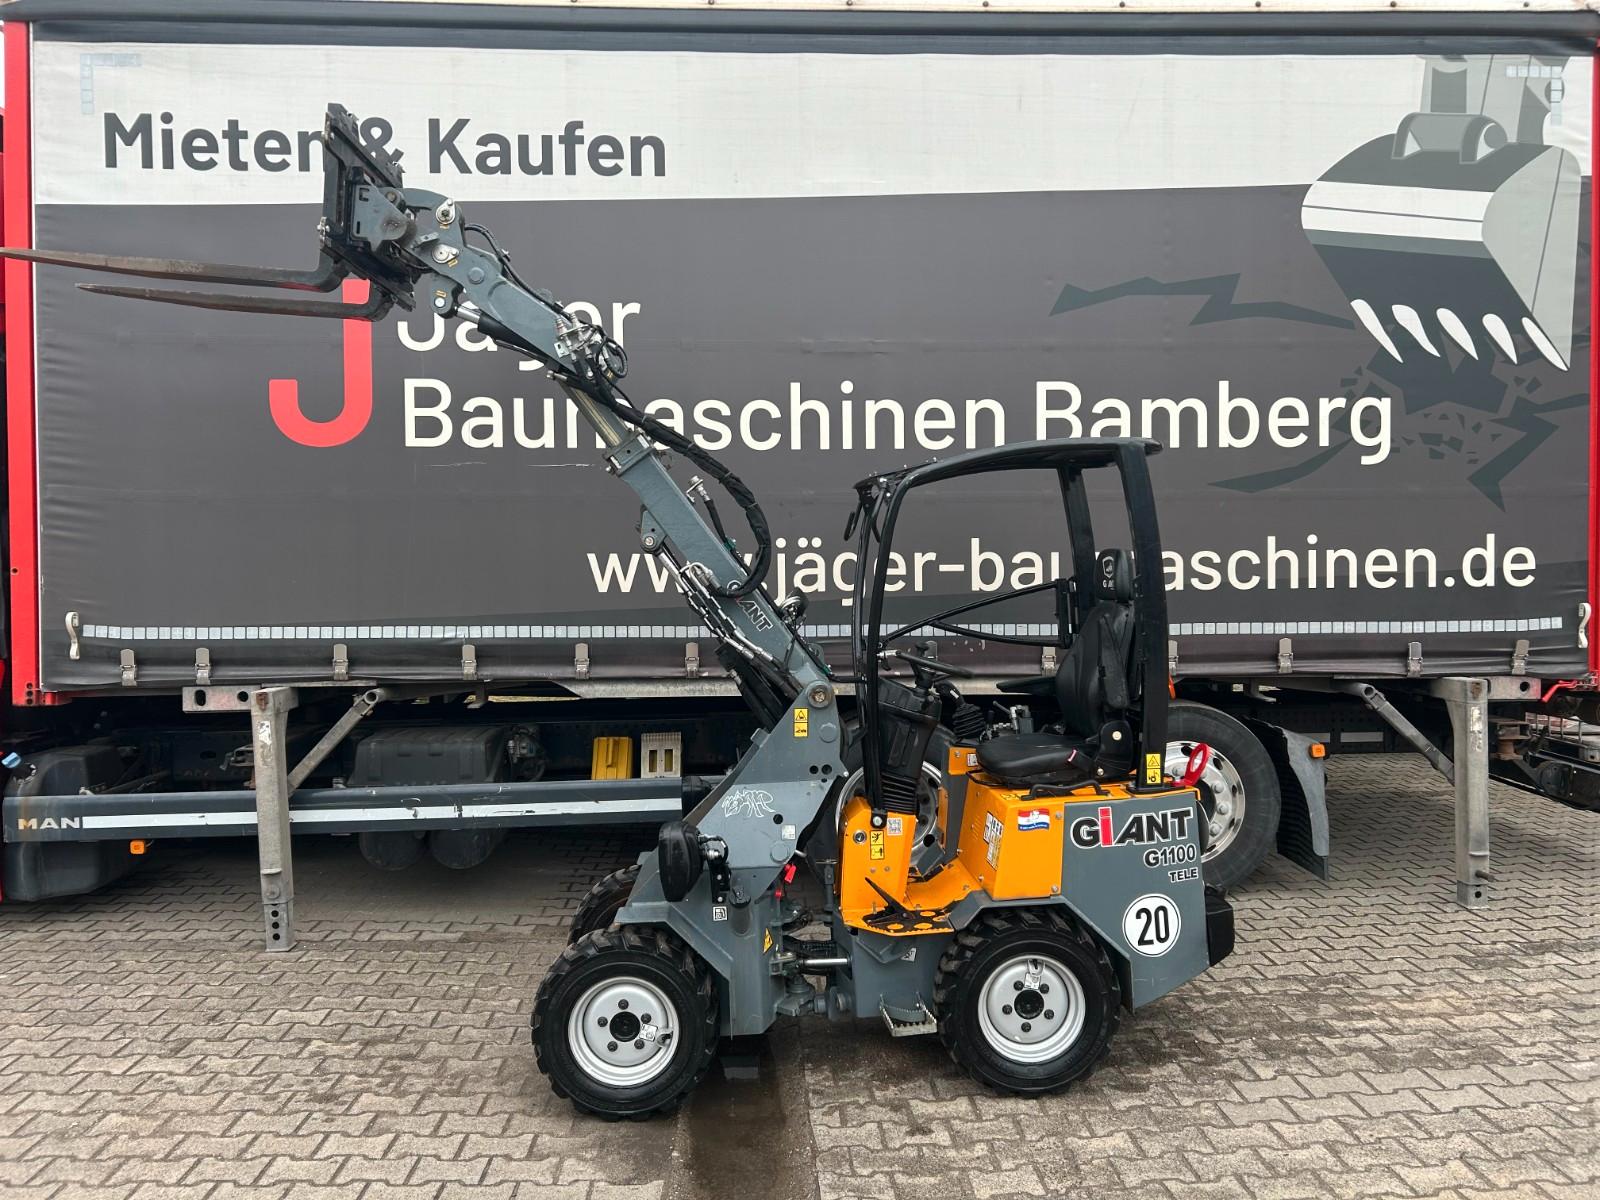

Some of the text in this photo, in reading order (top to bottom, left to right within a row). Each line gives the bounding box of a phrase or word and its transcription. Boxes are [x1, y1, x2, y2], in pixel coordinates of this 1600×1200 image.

[359, 116, 405, 163] &
[428, 117, 667, 177] Kaufen
[1035, 380, 1393, 465] Bamberg
[17, 816, 80, 830] MAN
[1143, 843, 1197, 869] G1100
[1168, 867, 1199, 883] TELE
[1135, 904, 1171, 947] 20
